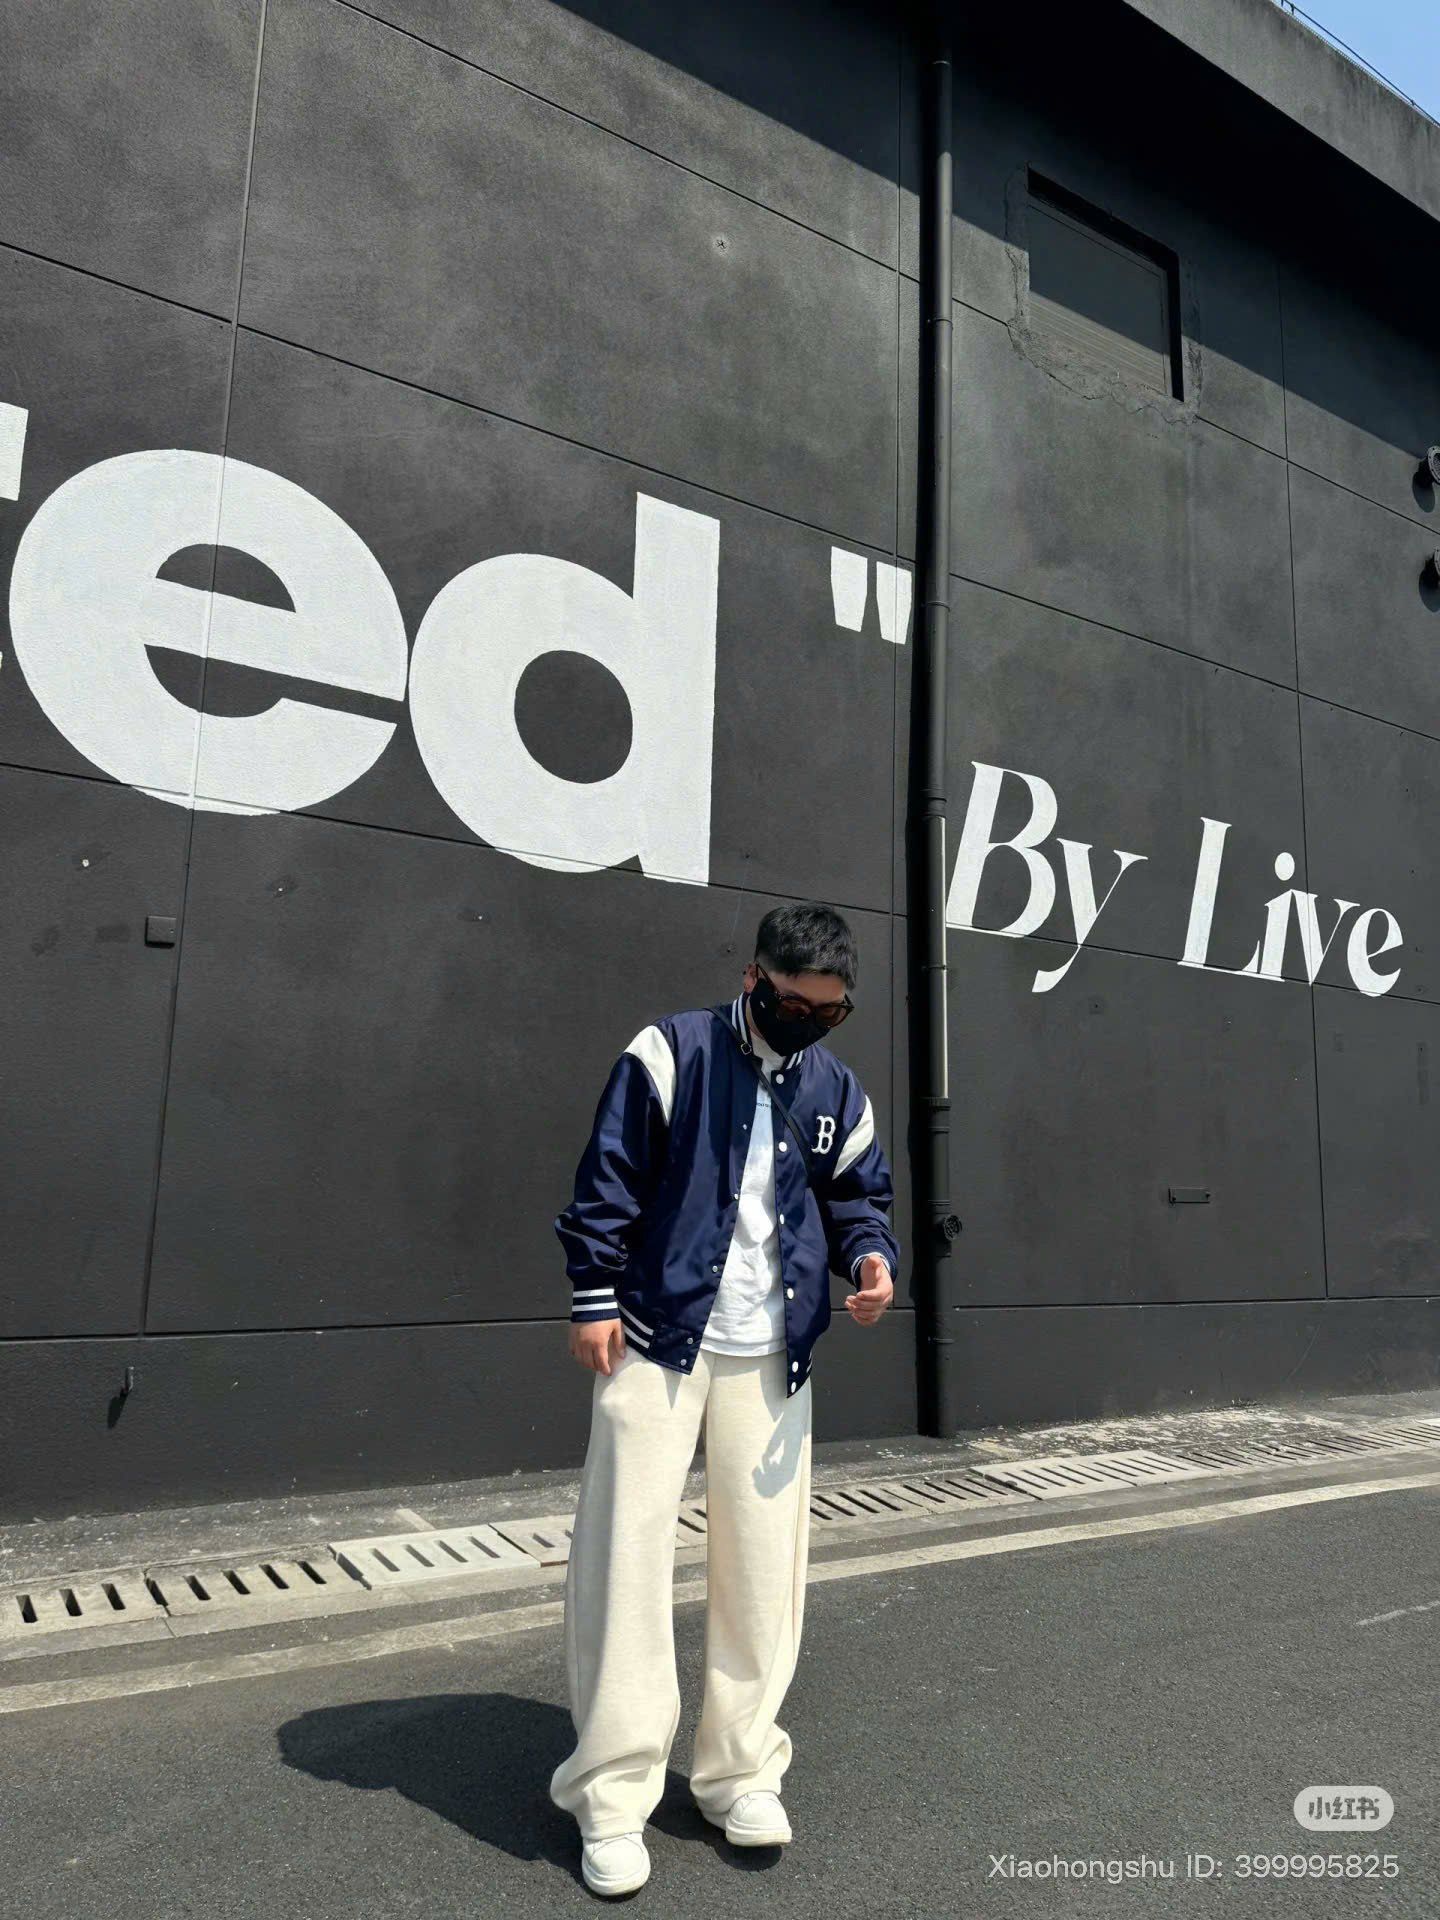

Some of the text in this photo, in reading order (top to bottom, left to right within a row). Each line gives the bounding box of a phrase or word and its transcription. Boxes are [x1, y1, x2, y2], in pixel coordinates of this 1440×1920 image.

[945, 761, 1404, 997] By Live
[810, 1114, 837, 1155] B
